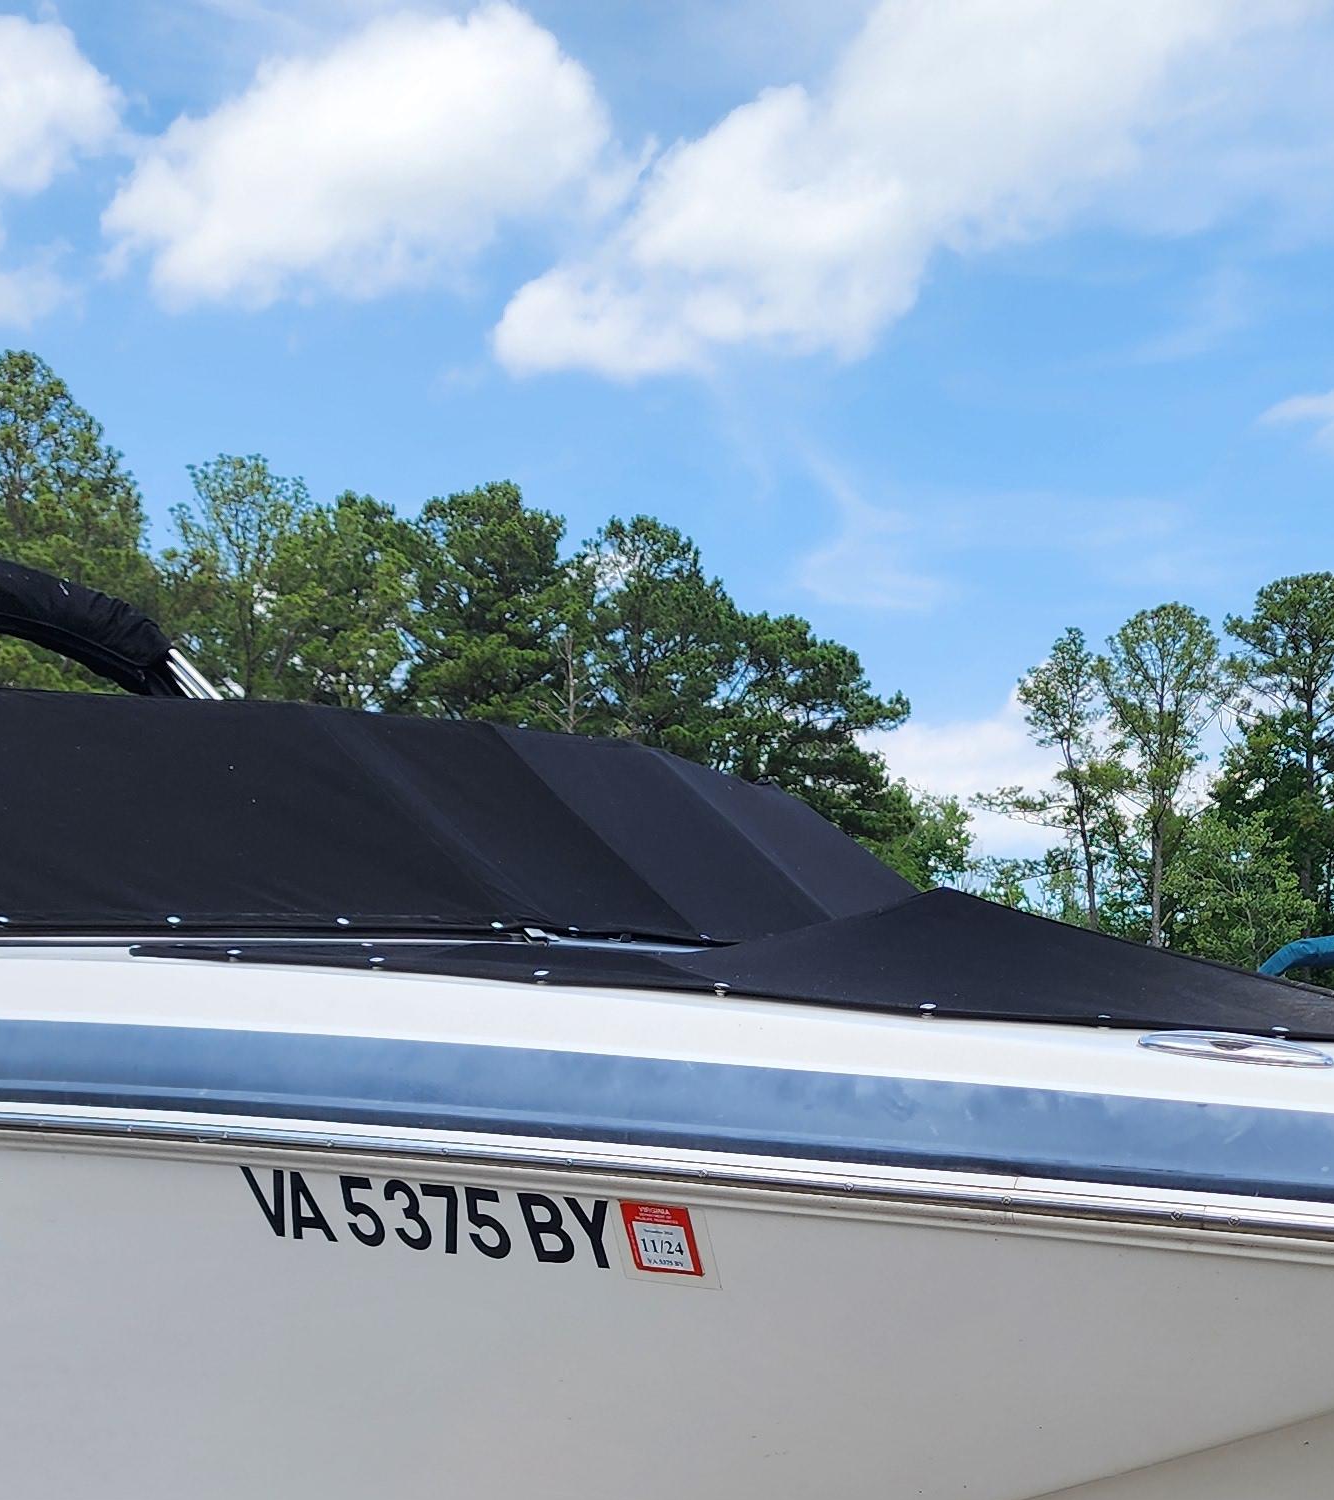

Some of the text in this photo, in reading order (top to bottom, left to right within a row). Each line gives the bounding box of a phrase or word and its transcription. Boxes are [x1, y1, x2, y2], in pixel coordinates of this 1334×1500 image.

[240, 1166, 338, 1242] VA
[340, 1175, 511, 1259] 5375
[516, 1193, 611, 1269] BY
[641, 1238, 684, 1255] 11/24
